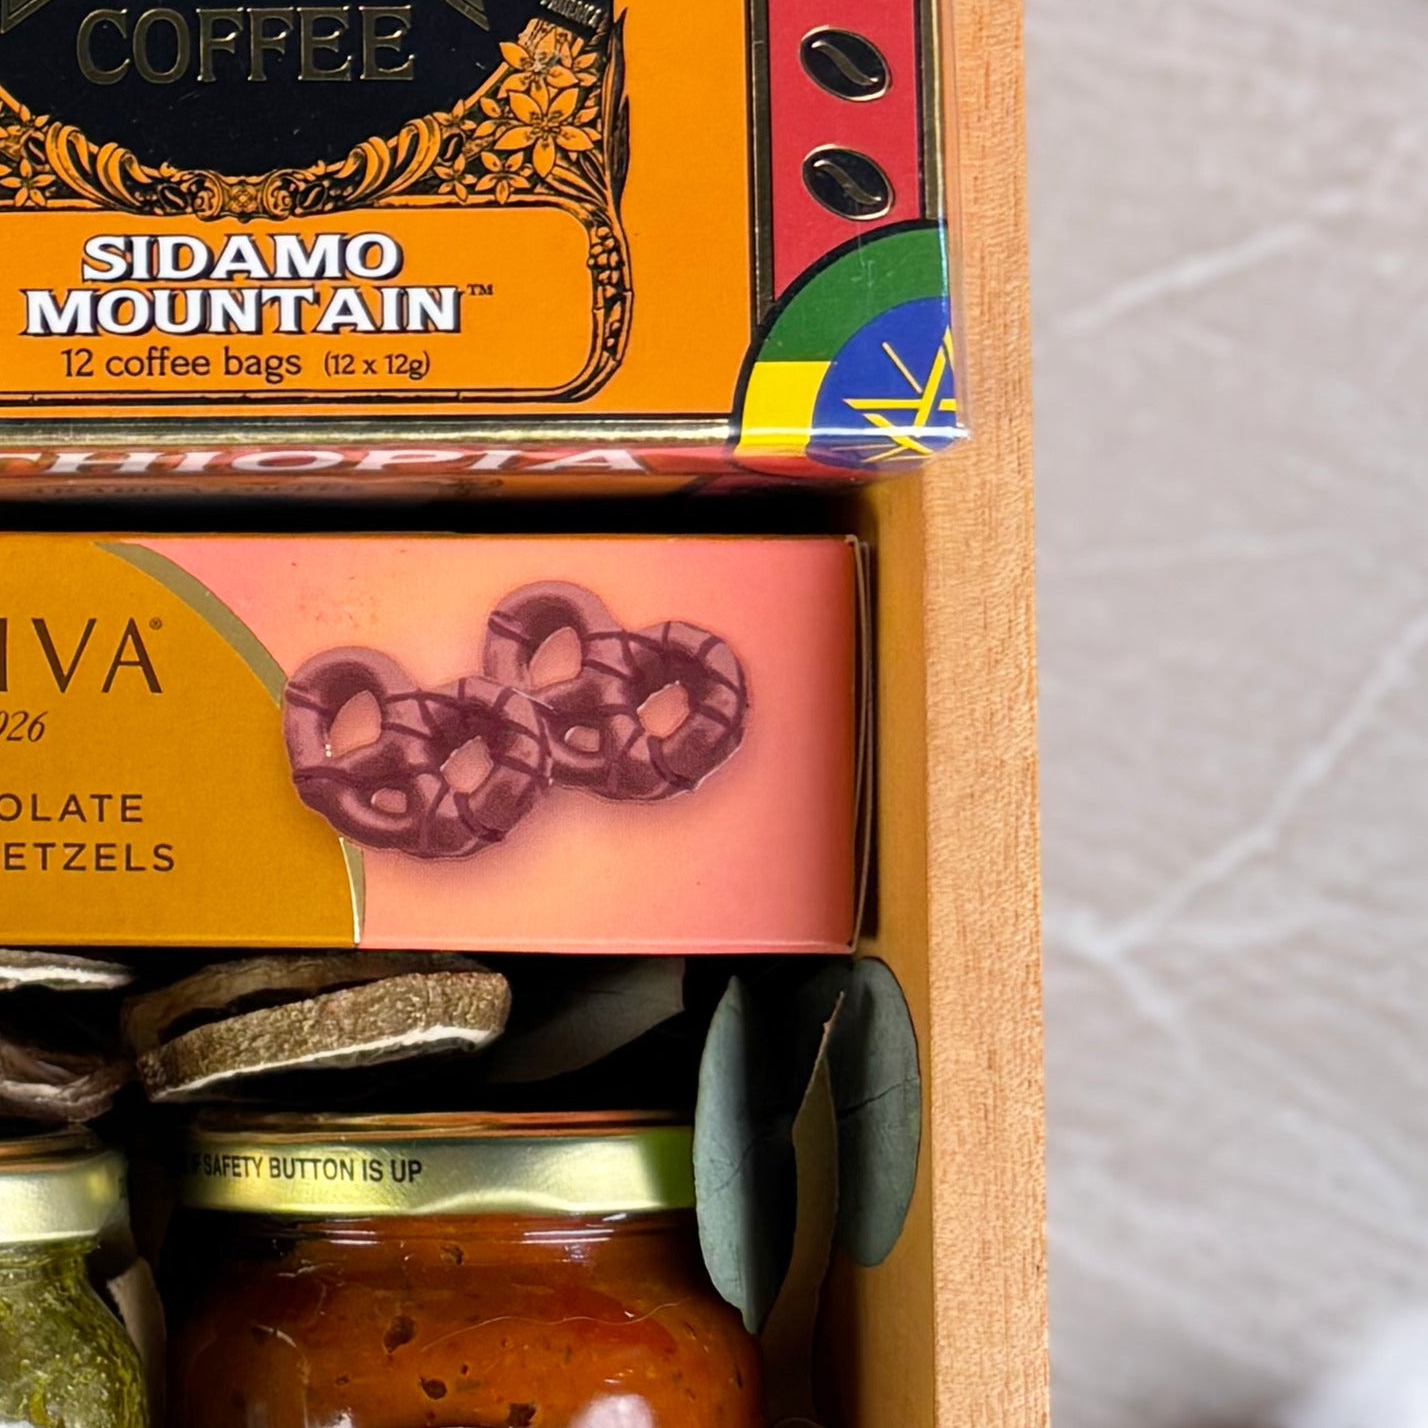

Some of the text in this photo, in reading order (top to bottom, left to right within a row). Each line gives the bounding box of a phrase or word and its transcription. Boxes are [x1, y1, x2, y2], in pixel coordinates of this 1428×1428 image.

[76, 5, 416, 84] COFFEE
[81, 232, 404, 283] SIDAMO
[19, 283, 464, 337] MOUNTAIN
[60, 346, 302, 384] 12 coffee bags
[269, 1157, 423, 1183] BUTTON IS UP
